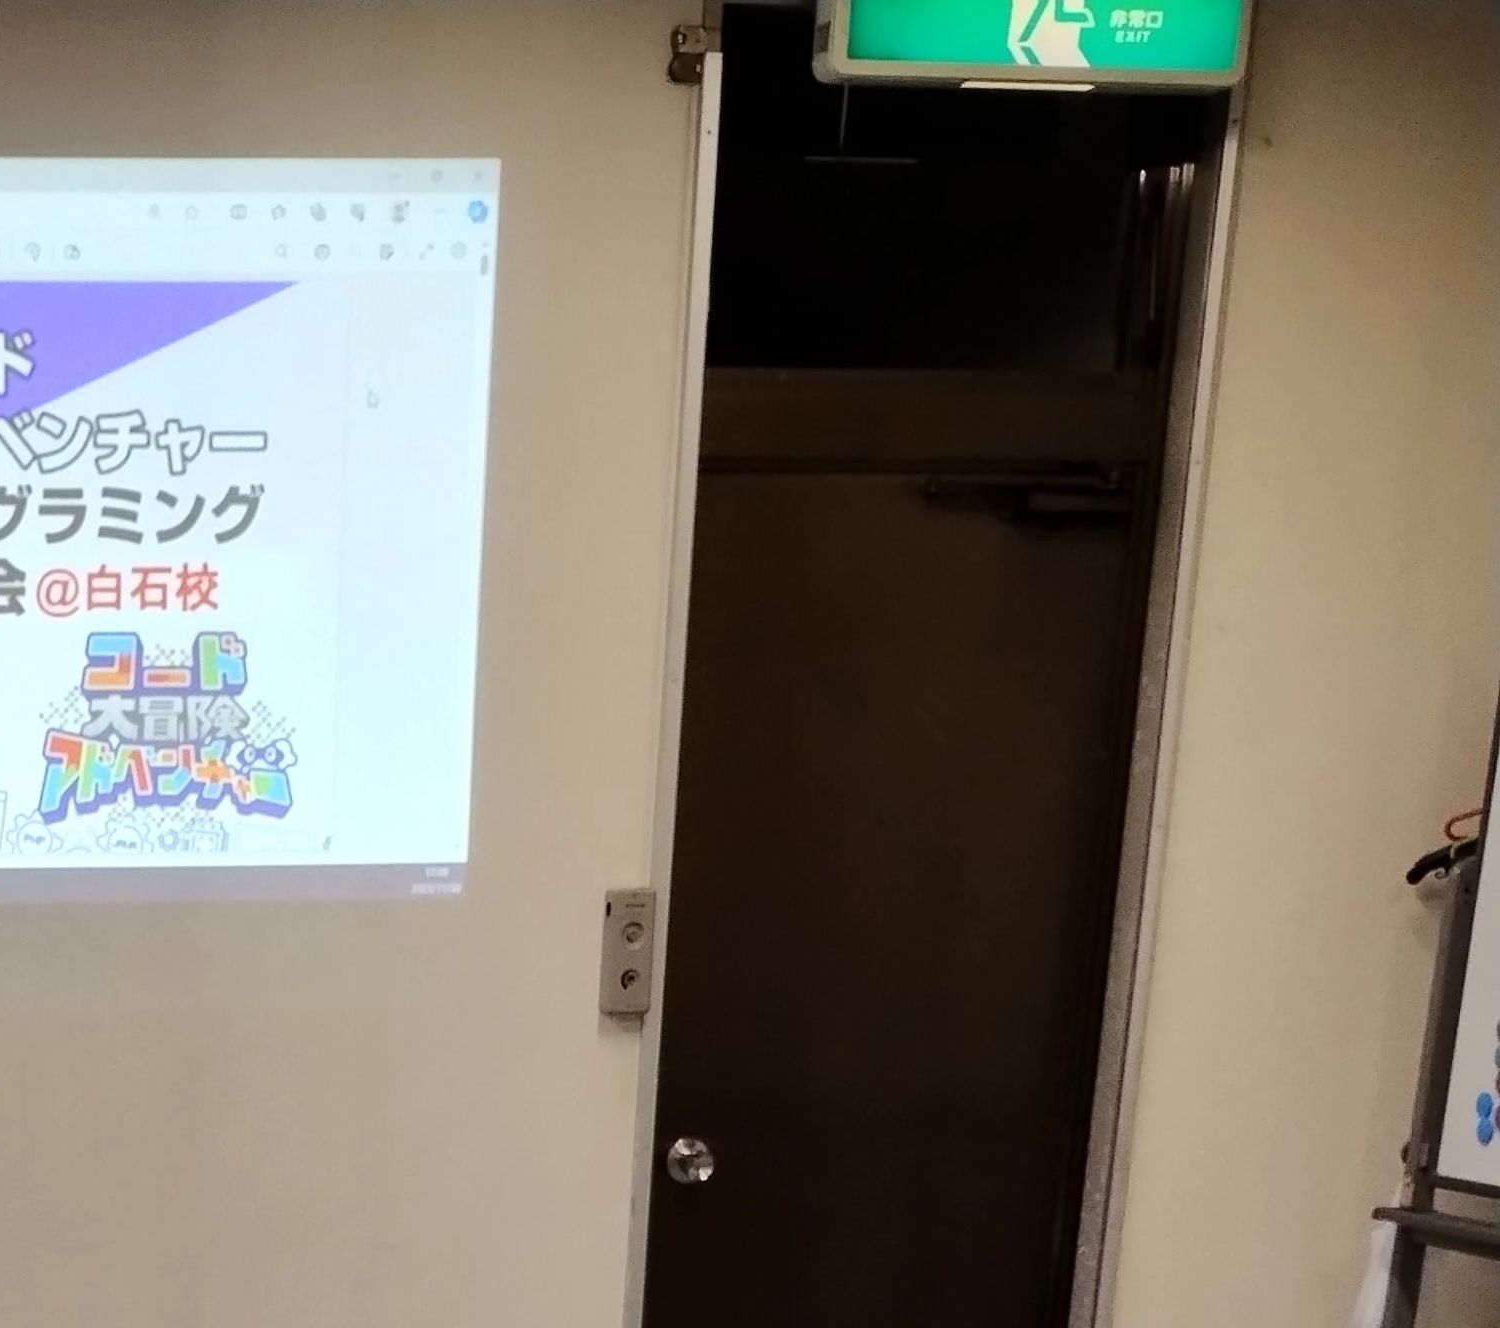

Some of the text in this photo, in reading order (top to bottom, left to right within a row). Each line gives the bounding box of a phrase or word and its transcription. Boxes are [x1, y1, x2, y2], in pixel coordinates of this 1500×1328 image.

[1109, 9, 1164, 29] 非常口
[1115, 30, 1151, 44] EXIT
[82, 631, 249, 697] コード
[81, 694, 250, 743] 大冒険
[38, 728, 294, 824] アドベンチャー
